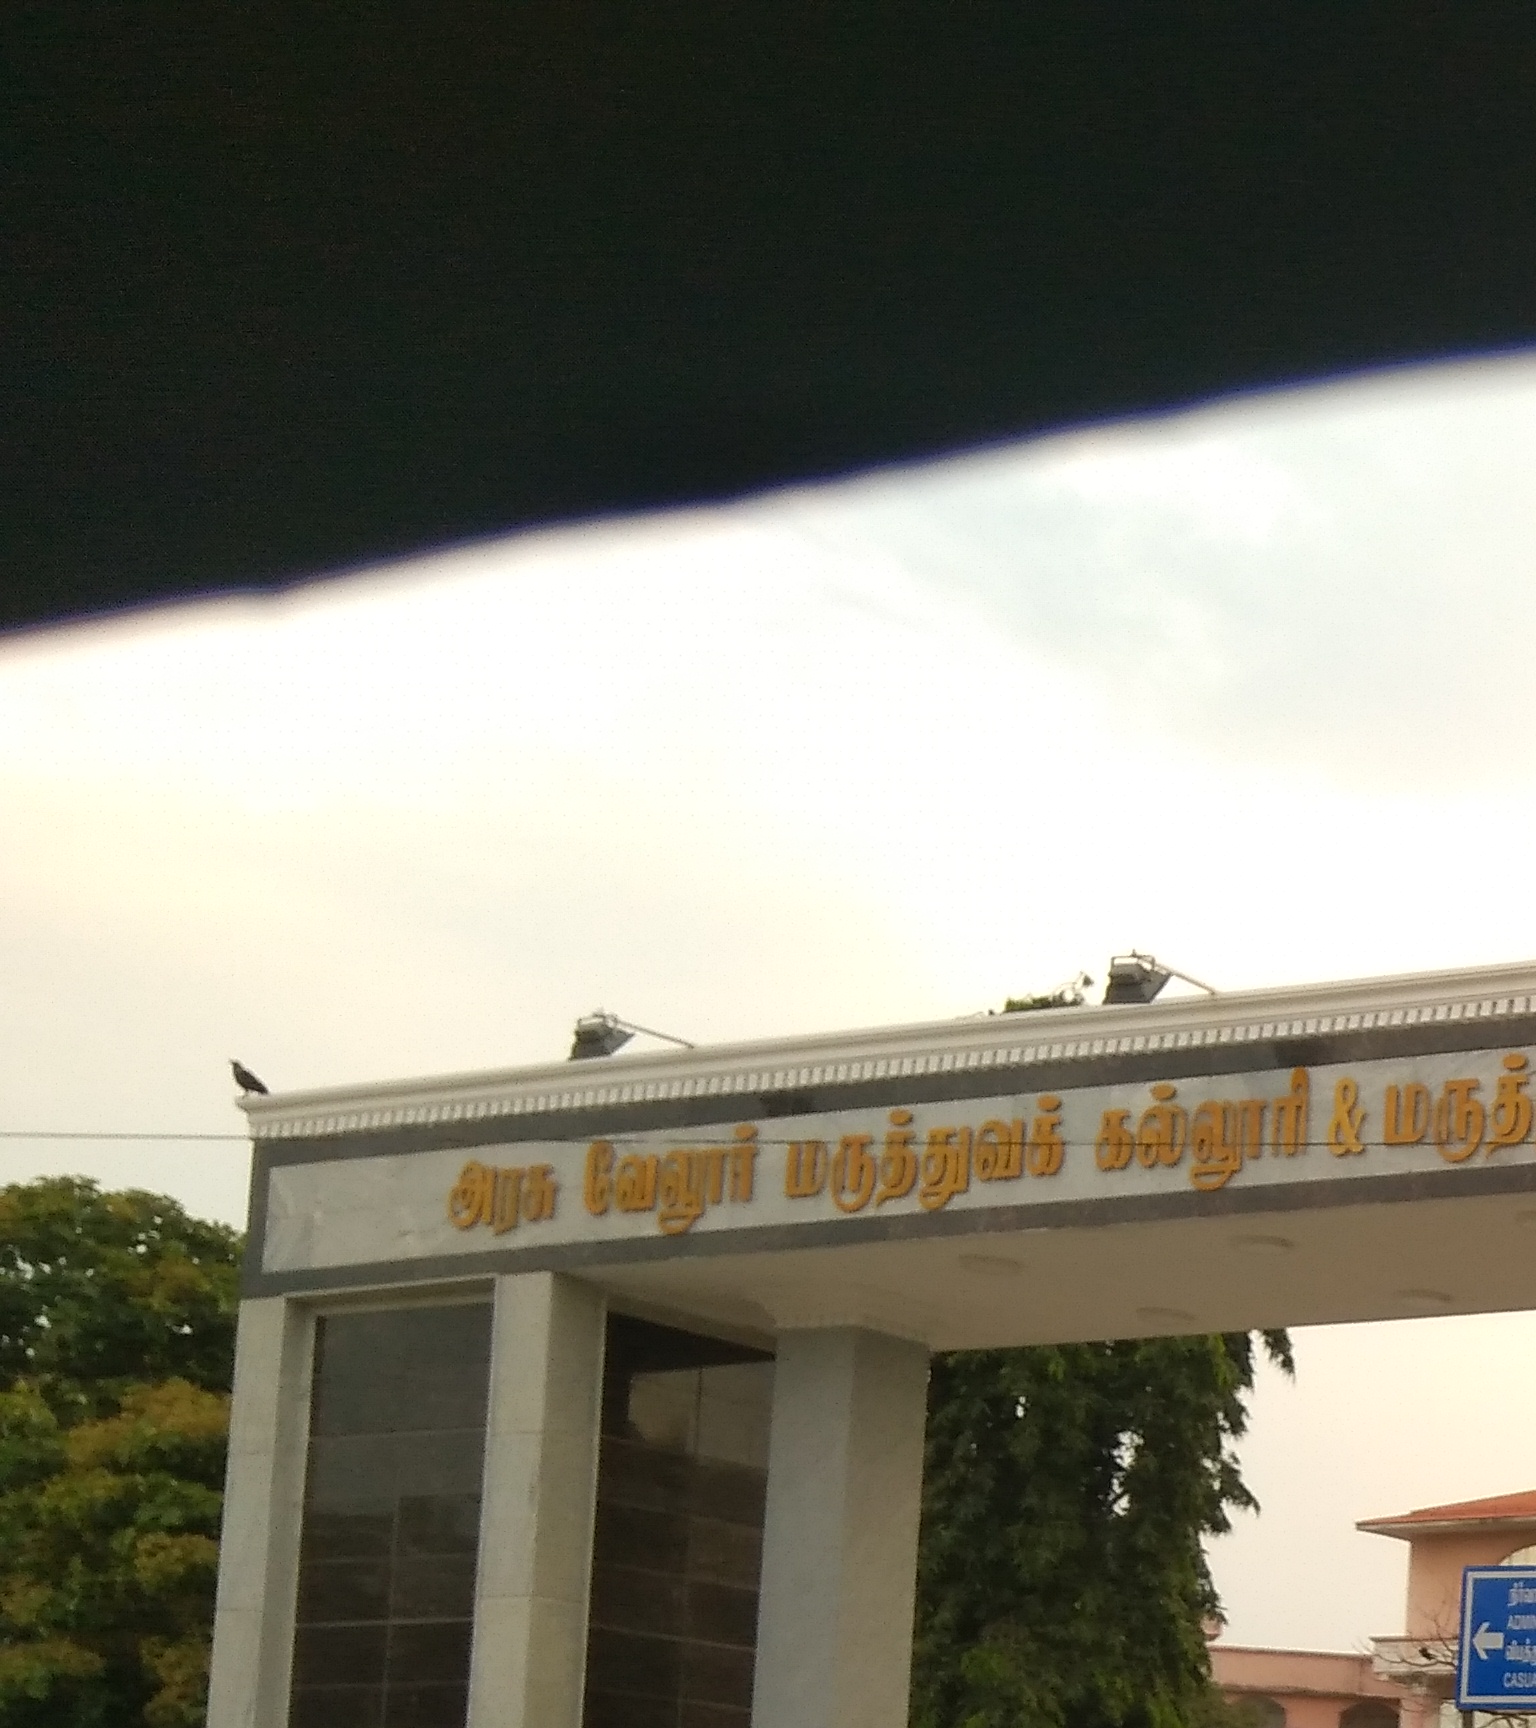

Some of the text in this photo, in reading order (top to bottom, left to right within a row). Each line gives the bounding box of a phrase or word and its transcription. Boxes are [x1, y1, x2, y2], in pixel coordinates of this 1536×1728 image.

[584, 1124, 757, 1236] வேலூர்
[784, 1096, 1064, 1214] மருத்துவக்
[1094, 1065, 1309, 1190] கல்லூரி
[1326, 1078, 1364, 1156] &
